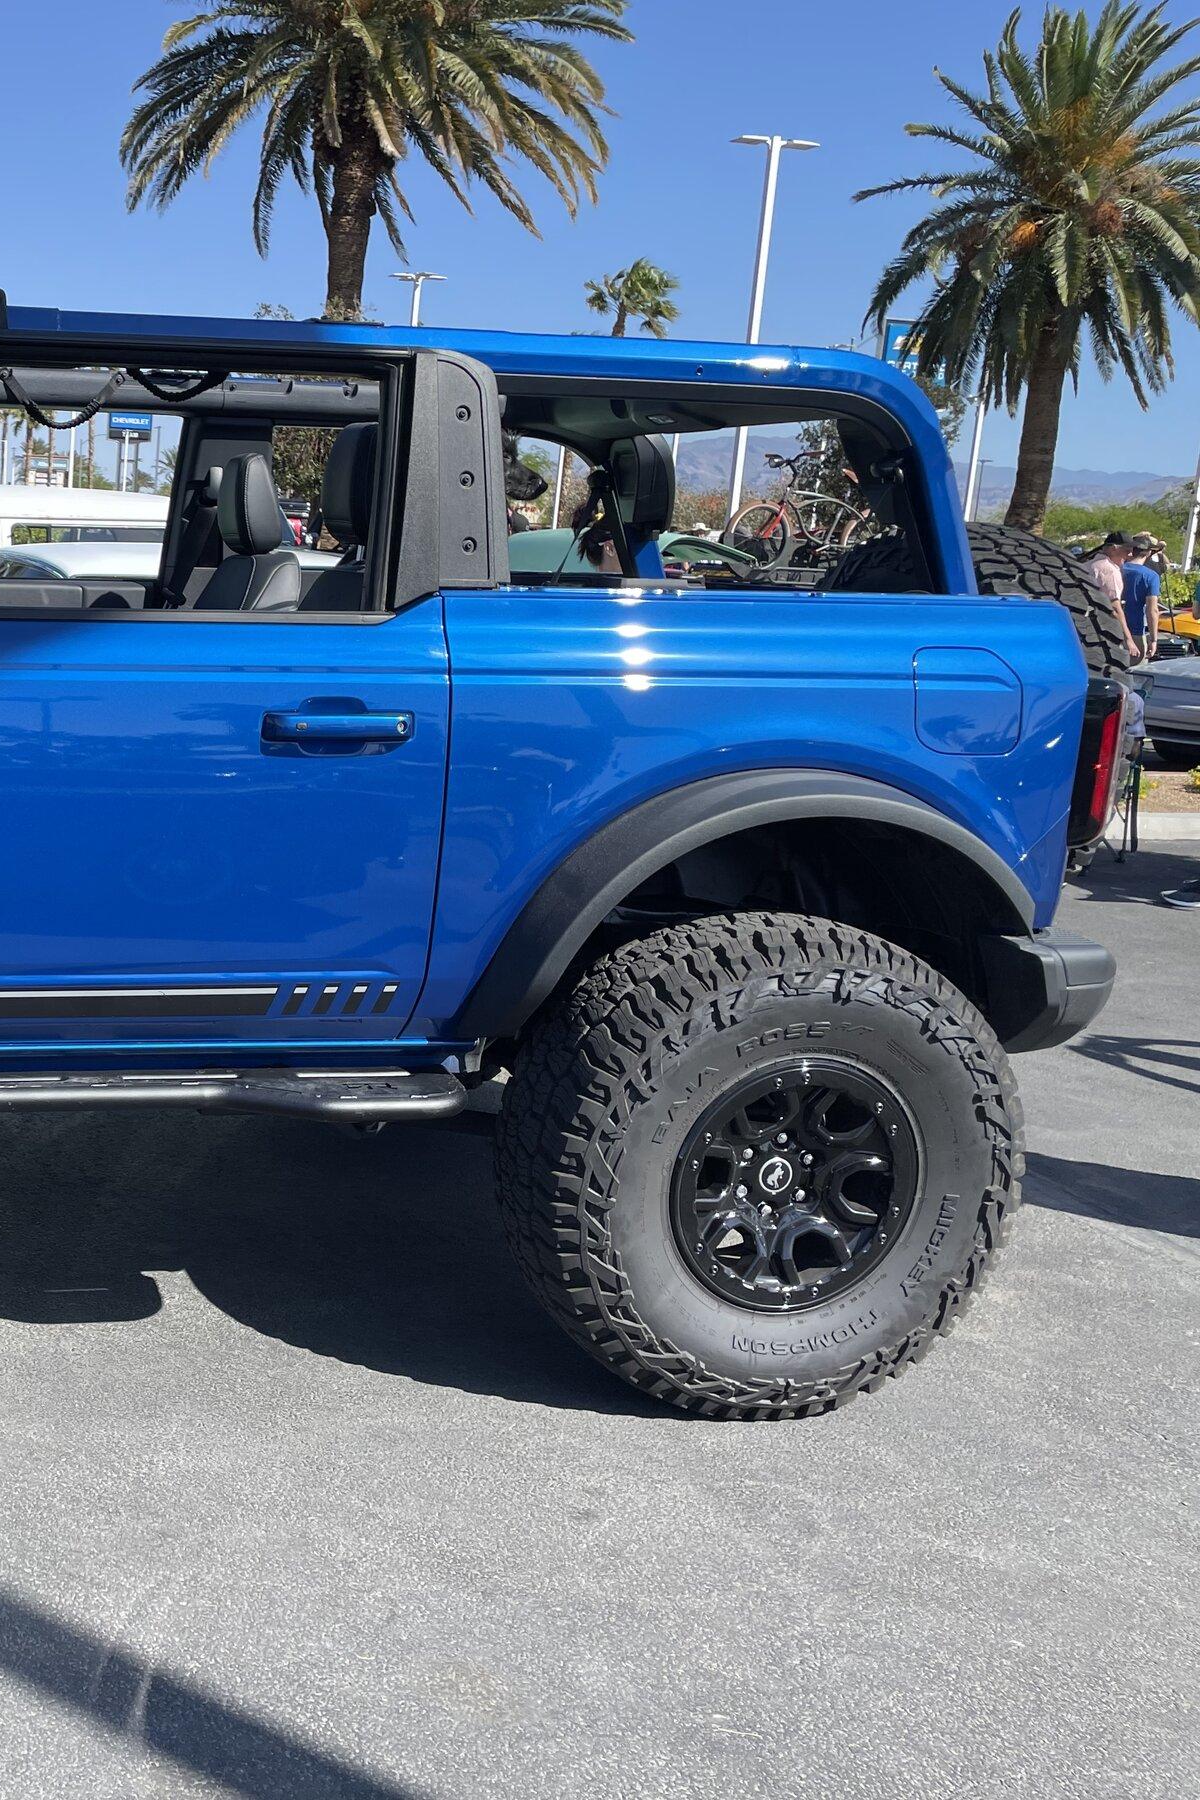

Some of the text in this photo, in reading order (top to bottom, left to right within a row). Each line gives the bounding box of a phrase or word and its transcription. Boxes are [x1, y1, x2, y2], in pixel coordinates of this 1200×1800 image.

[112, 416, 150, 425] CHEVROLET
[651, 1065, 720, 1144] BAJA
[736, 1020, 832, 1057] BOSS
[899, 1193, 961, 1298] MICKEY
[731, 1306, 883, 1356] THOMPSON
